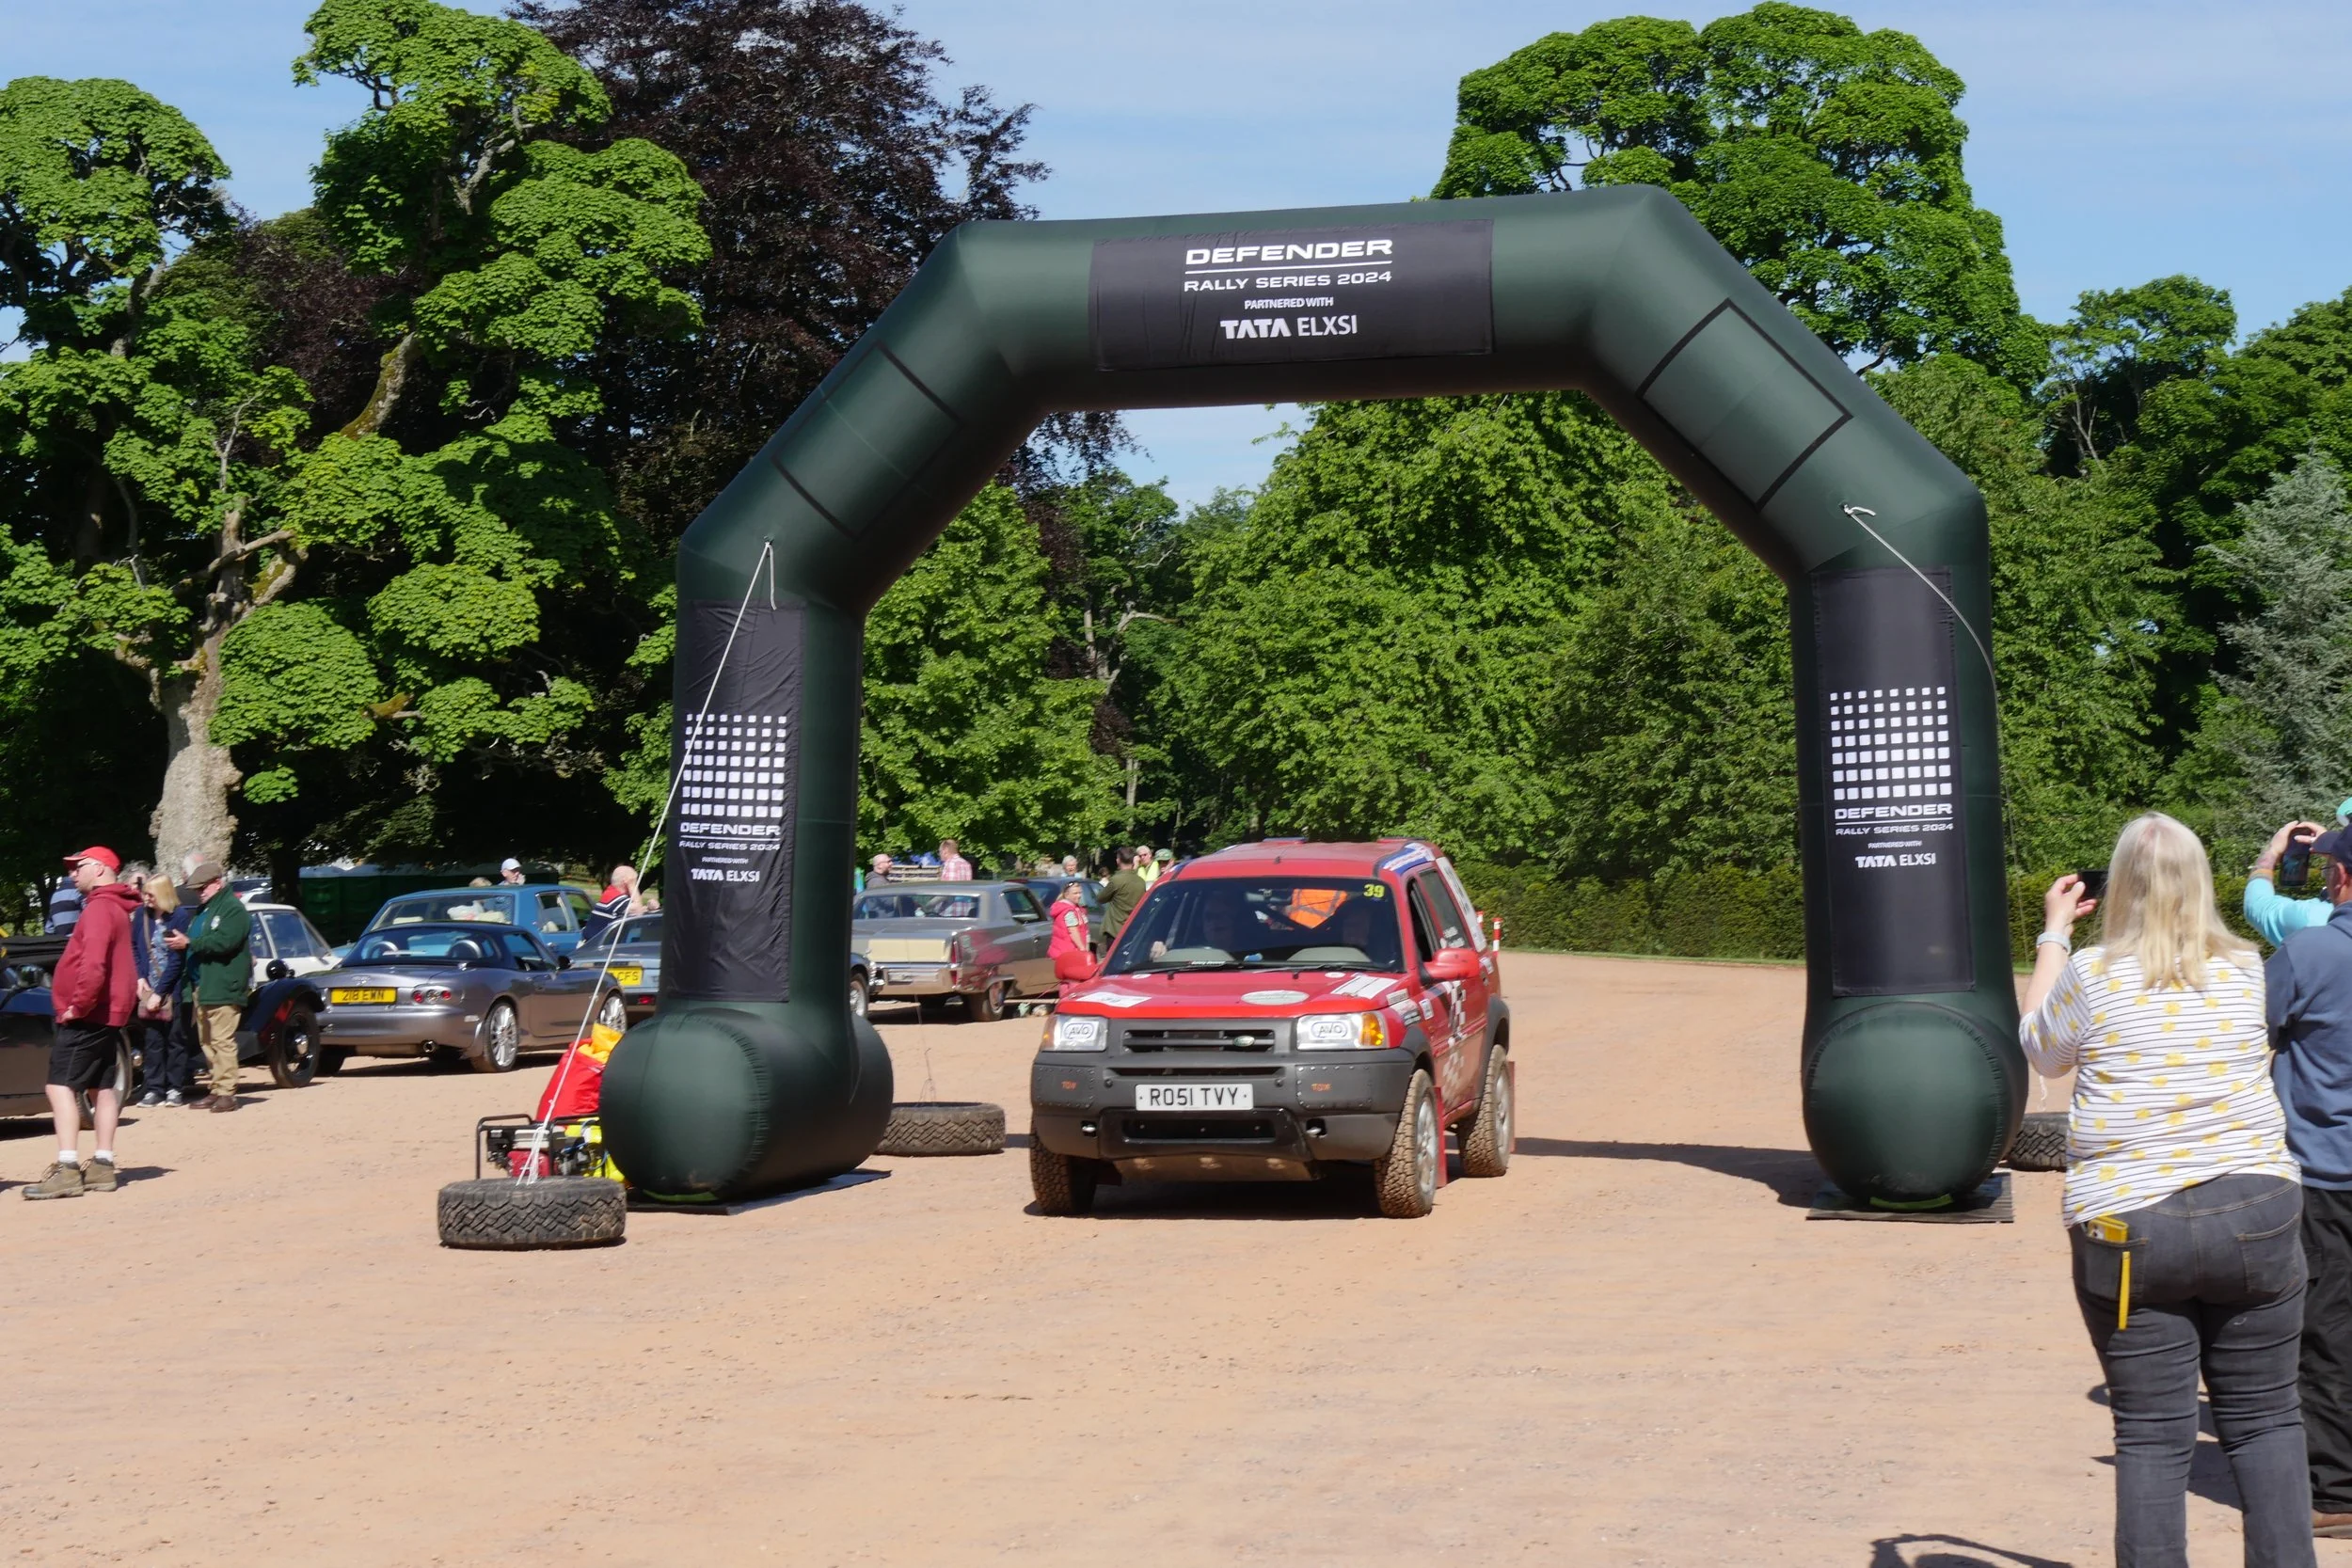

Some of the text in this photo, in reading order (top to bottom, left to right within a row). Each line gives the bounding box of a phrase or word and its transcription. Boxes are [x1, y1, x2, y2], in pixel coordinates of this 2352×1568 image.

[1185, 239, 1392, 264] DEFENDER
[1184, 271, 1392, 292] RALLY SERIES 2024
[1244, 297, 1334, 309] PARTNERED WITH
[1219, 314, 1358, 340] TATA ELXSI
[1835, 803, 1953, 819] DEFENDER
[679, 822, 781, 835] DEFENDER
[1836, 823, 1954, 835] RALLY SERIES 2024
[707, 842, 748, 850] SERIES
[1854, 852, 1936, 868] TATA ELXSI
[691, 868, 760, 882] TATA ELXSI
[1363, 884, 1385, 898] 39
[342, 989, 359, 1001] 218
[1069, 1024, 1089, 1035] AVO
[1318, 1022, 1343, 1035] AVO
[1200, 1087, 1238, 1106] TVY
